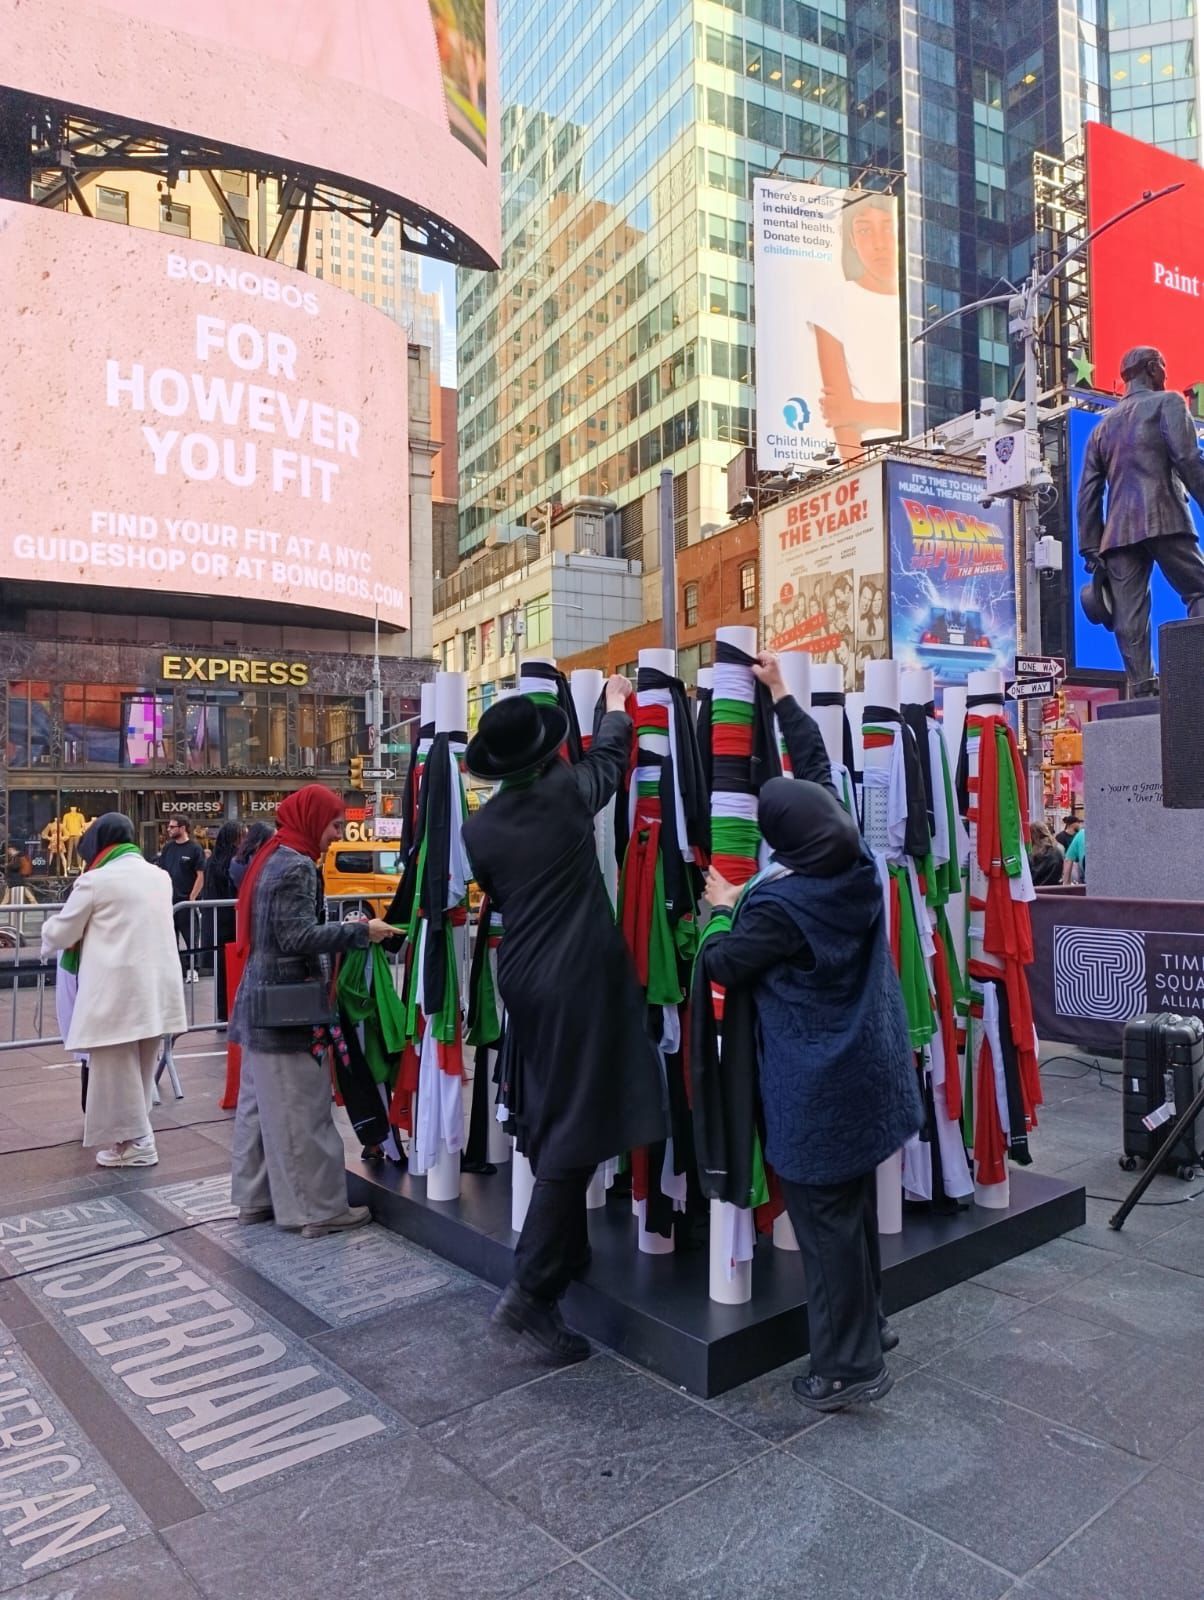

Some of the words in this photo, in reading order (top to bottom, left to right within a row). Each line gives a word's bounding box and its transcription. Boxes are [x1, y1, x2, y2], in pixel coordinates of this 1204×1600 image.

[760, 188, 798, 202] There's
[800, 195, 806, 203] a
[807, 195, 835, 207] crisis
[762, 202, 773, 212] in
[774, 204, 824, 219] children's
[763, 218, 799, 229] mental
[801, 220, 836, 234] health.
[763, 229, 800, 243] Donate
[802, 235, 833, 249] today.
[763, 244, 833, 262] childmind.org
[166, 253, 320, 315] BONOBOS
[1153, 262, 1199, 297] Paint
[194, 314, 297, 380] FOR
[105, 360, 361, 459] HOWEVER
[766, 434, 798, 447] Child
[800, 437, 828, 448] Mind
[774, 447, 815, 460] Institut
[142, 425, 257, 488] YOU
[272, 447, 340, 504] FIT
[911, 473, 927, 485] IT'S
[928, 476, 948, 488] TIME
[949, 479, 960, 489] TO
[898, 481, 936, 496] MUSICAL
[935, 487, 972, 502] THEATER
[787, 491, 832, 527] BEST
[835, 478, 860, 506] OF
[778, 521, 812, 551] THE
[815, 499, 868, 537] YEAR!
[900, 497, 1004, 541] BACK
[91, 511, 158, 540] FIND
[164, 518, 238, 549] YOUR
[244, 527, 281, 554] FIT
[285, 535, 314, 560] AT
[318, 541, 333, 565] A
[335, 544, 372, 573] NYC
[912, 538, 934, 556] TO
[934, 539, 1005, 568] FUTURE
[13, 533, 187, 572] GUIDESHOP
[191, 551, 228, 577] OR
[235, 556, 266, 581] AT
[271, 560, 404, 609] BONOBOS.COM
[957, 566, 972, 577] THE
[973, 562, 1004, 574] MUSICAL
[161, 655, 309, 686] EXPRESS
[1022, 663, 1037, 672] ONE
[1042, 664, 1058, 673] WAY
[1011, 686, 1025, 694] ONE
[1031, 683, 1048, 692] WAY
[162, 802, 221, 812] EXPRESS
[1160, 953, 1204, 971] TIM
[1161, 994, 1204, 1009] ALLIA
[0, 1200, 118, 1240] NEW
[1, 1218, 387, 1494] AMSTERDAM
